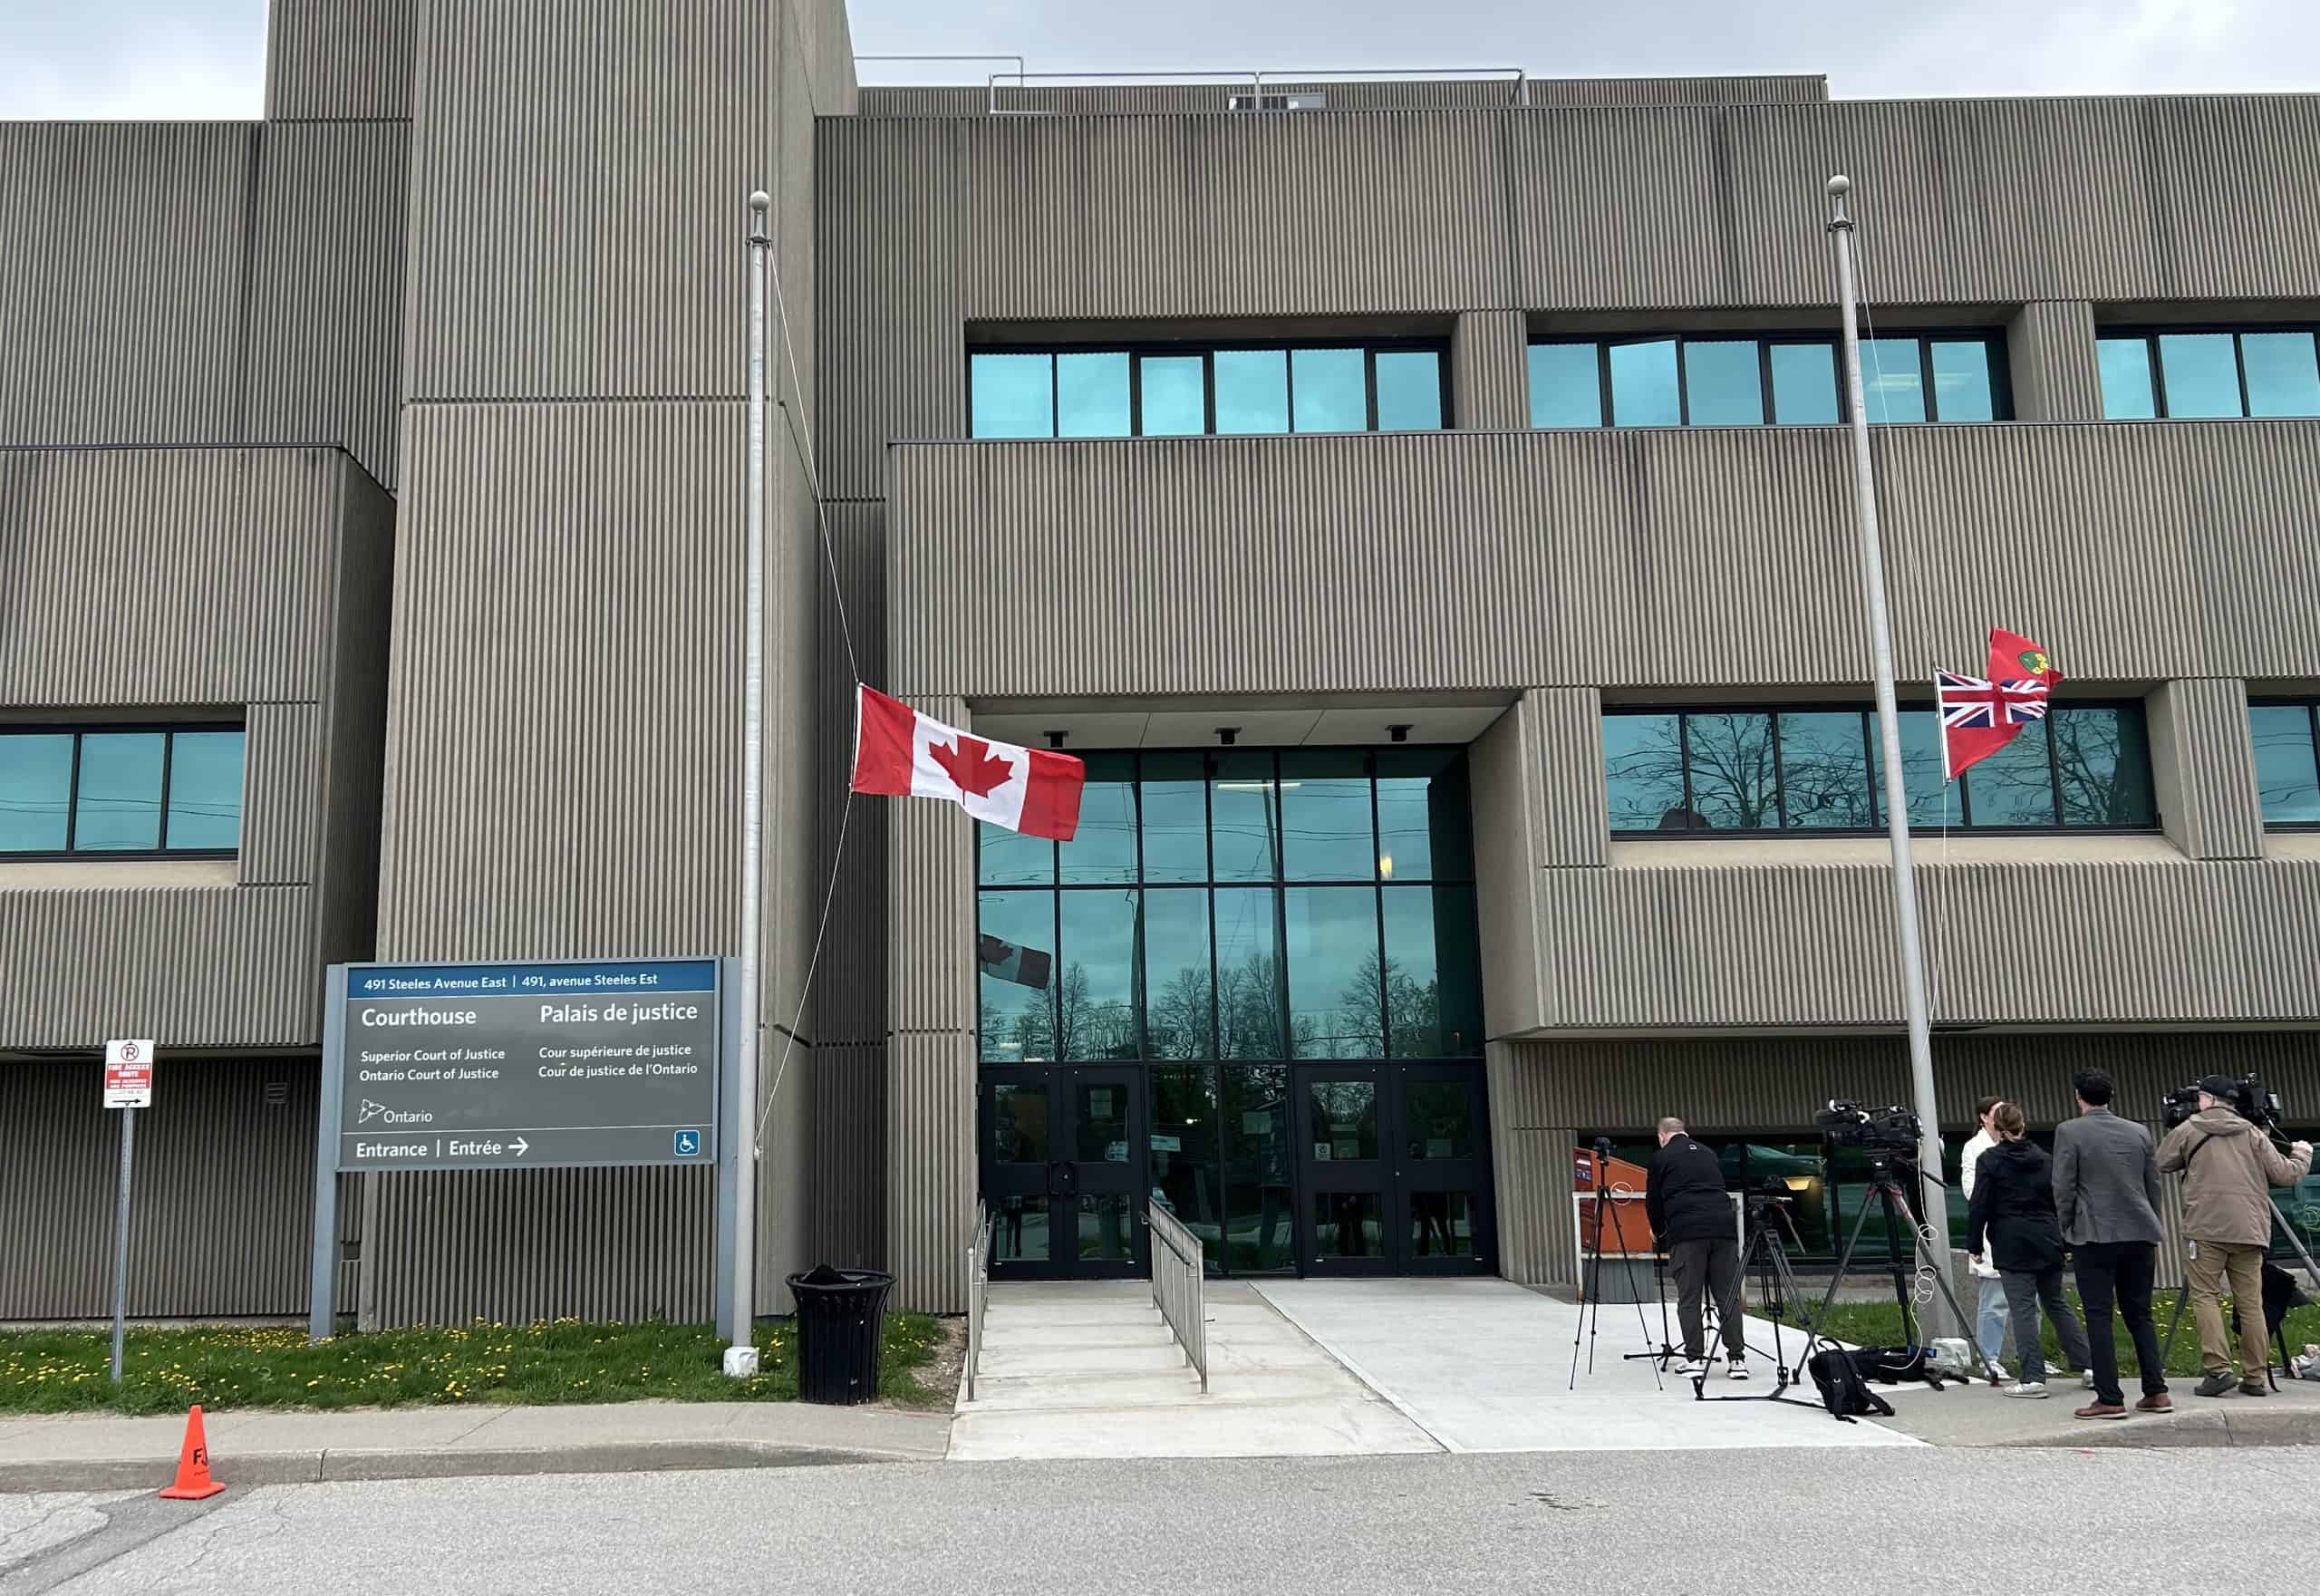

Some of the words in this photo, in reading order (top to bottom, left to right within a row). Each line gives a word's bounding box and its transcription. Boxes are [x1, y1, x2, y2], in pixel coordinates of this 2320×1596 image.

[363, 978, 386, 991] 491
[388, 978, 431, 990] Steeles
[433, 978, 479, 990] Avenue
[481, 976, 507, 988] East
[521, 975, 546, 989] 491,
[548, 977, 593, 987] avenue
[594, 973, 637, 986] Steeles
[639, 973, 658, 985] Est
[362, 1007, 477, 1027] Courthouse
[540, 1003, 598, 1023] Palais
[603, 1002, 628, 1021] de
[630, 1001, 698, 1025] justice
[361, 1049, 411, 1065] Superior
[413, 1049, 448, 1061] Court
[449, 1048, 463, 1060] of
[463, 1048, 506, 1060] Justice
[538, 1047, 567, 1059] Cour
[569, 1045, 633, 1060] supérieure
[634, 1044, 651, 1057] de
[651, 1044, 692, 1059] justice
[359, 1069, 405, 1082] Ontario
[407, 1069, 441, 1080] Court
[442, 1068, 457, 1079] of
[457, 1068, 499, 1079] Justice
[538, 1066, 567, 1078] Cour
[569, 1065, 585, 1077] de
[585, 1065, 626, 1079] justice
[627, 1063, 643, 1076] de
[383, 1109, 433, 1124] Ontario
[355, 1142, 428, 1158] Entrance
[449, 1139, 502, 1156] Entrée
